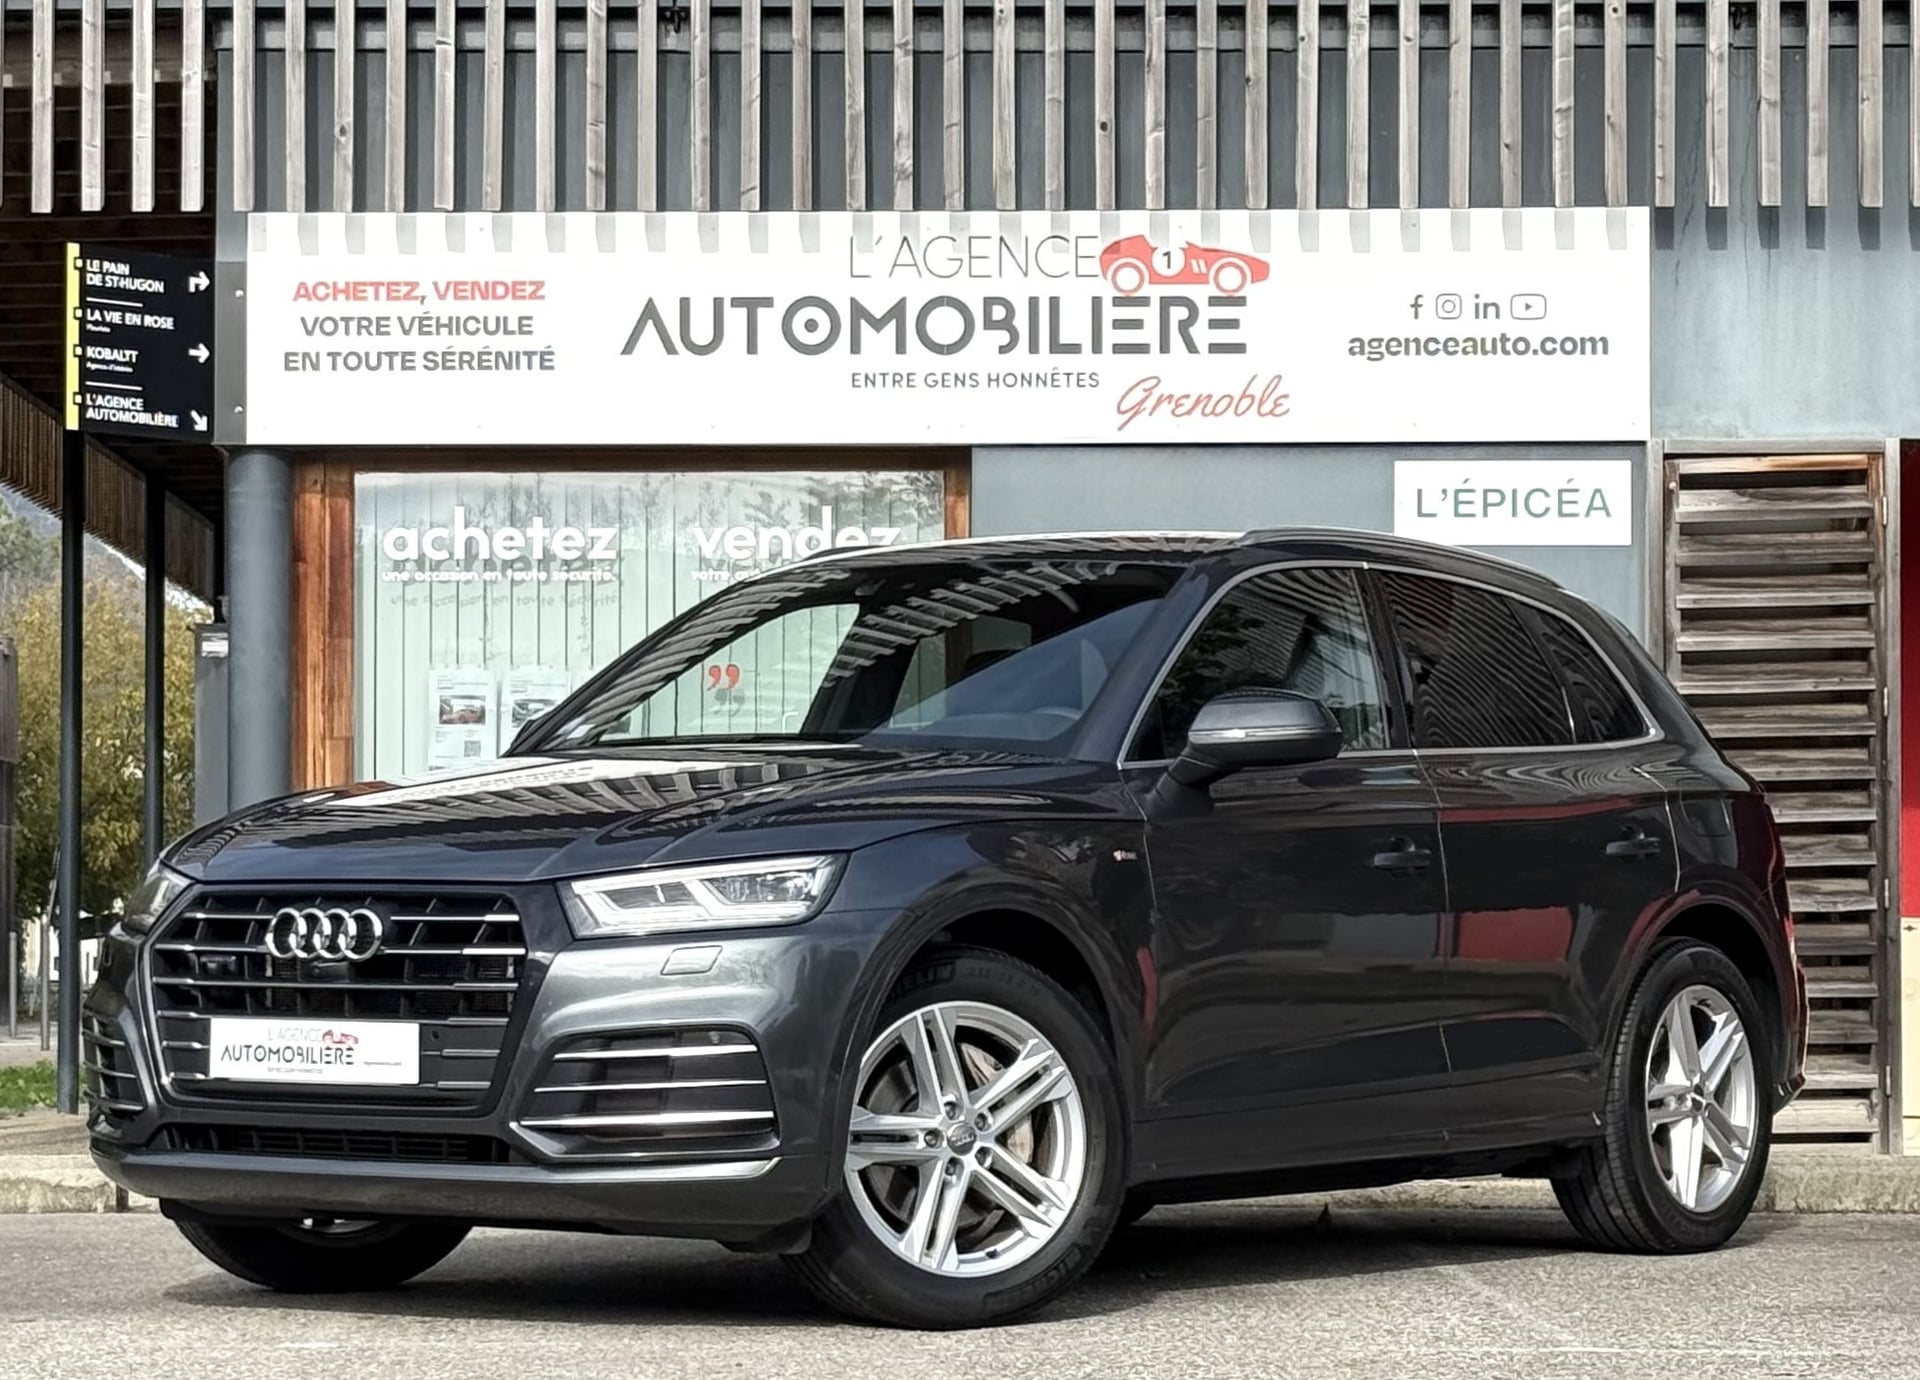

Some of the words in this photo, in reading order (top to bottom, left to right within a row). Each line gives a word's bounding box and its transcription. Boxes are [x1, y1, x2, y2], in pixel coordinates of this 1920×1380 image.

[86, 259, 101, 272] LE
[102, 261, 130, 275] PAIN
[851, 235, 1099, 279] L'AGENCE
[86, 273, 103, 286] DE
[293, 281, 427, 306] ACHETEZ,
[432, 281, 546, 301] VENDEZ
[86, 308, 102, 322] LA
[103, 310, 123, 324] VIE
[124, 313, 142, 326] EN
[143, 315, 175, 330] ROSE
[300, 316, 391, 337] VOTRE
[397, 311, 534, 337] VÉHICULE
[284, 351, 321, 372] EN
[327, 351, 417, 372] TOUTE
[423, 345, 556, 371] SÉRÉNITÉ
[1348, 333, 1609, 362] agenceauto.com
[851, 372, 917, 389] ENTRE
[923, 372, 980, 389] GENS
[987, 366, 1100, 389] HONNÊTES
[86, 393, 144, 411] L'AGENCE
[1116, 374, 1291, 432] Grenoble
[86, 407, 179, 428] AUTOMOBILIÈRE
[1416, 478, 1612, 518] L'ÉPICÉA
[383, 506, 618, 561] achetez
[692, 505, 902, 560] vendez
[382, 570, 411, 581] une
[414, 567, 479, 582] occasion
[483, 570, 502, 582] en
[506, 568, 548, 582] toute
